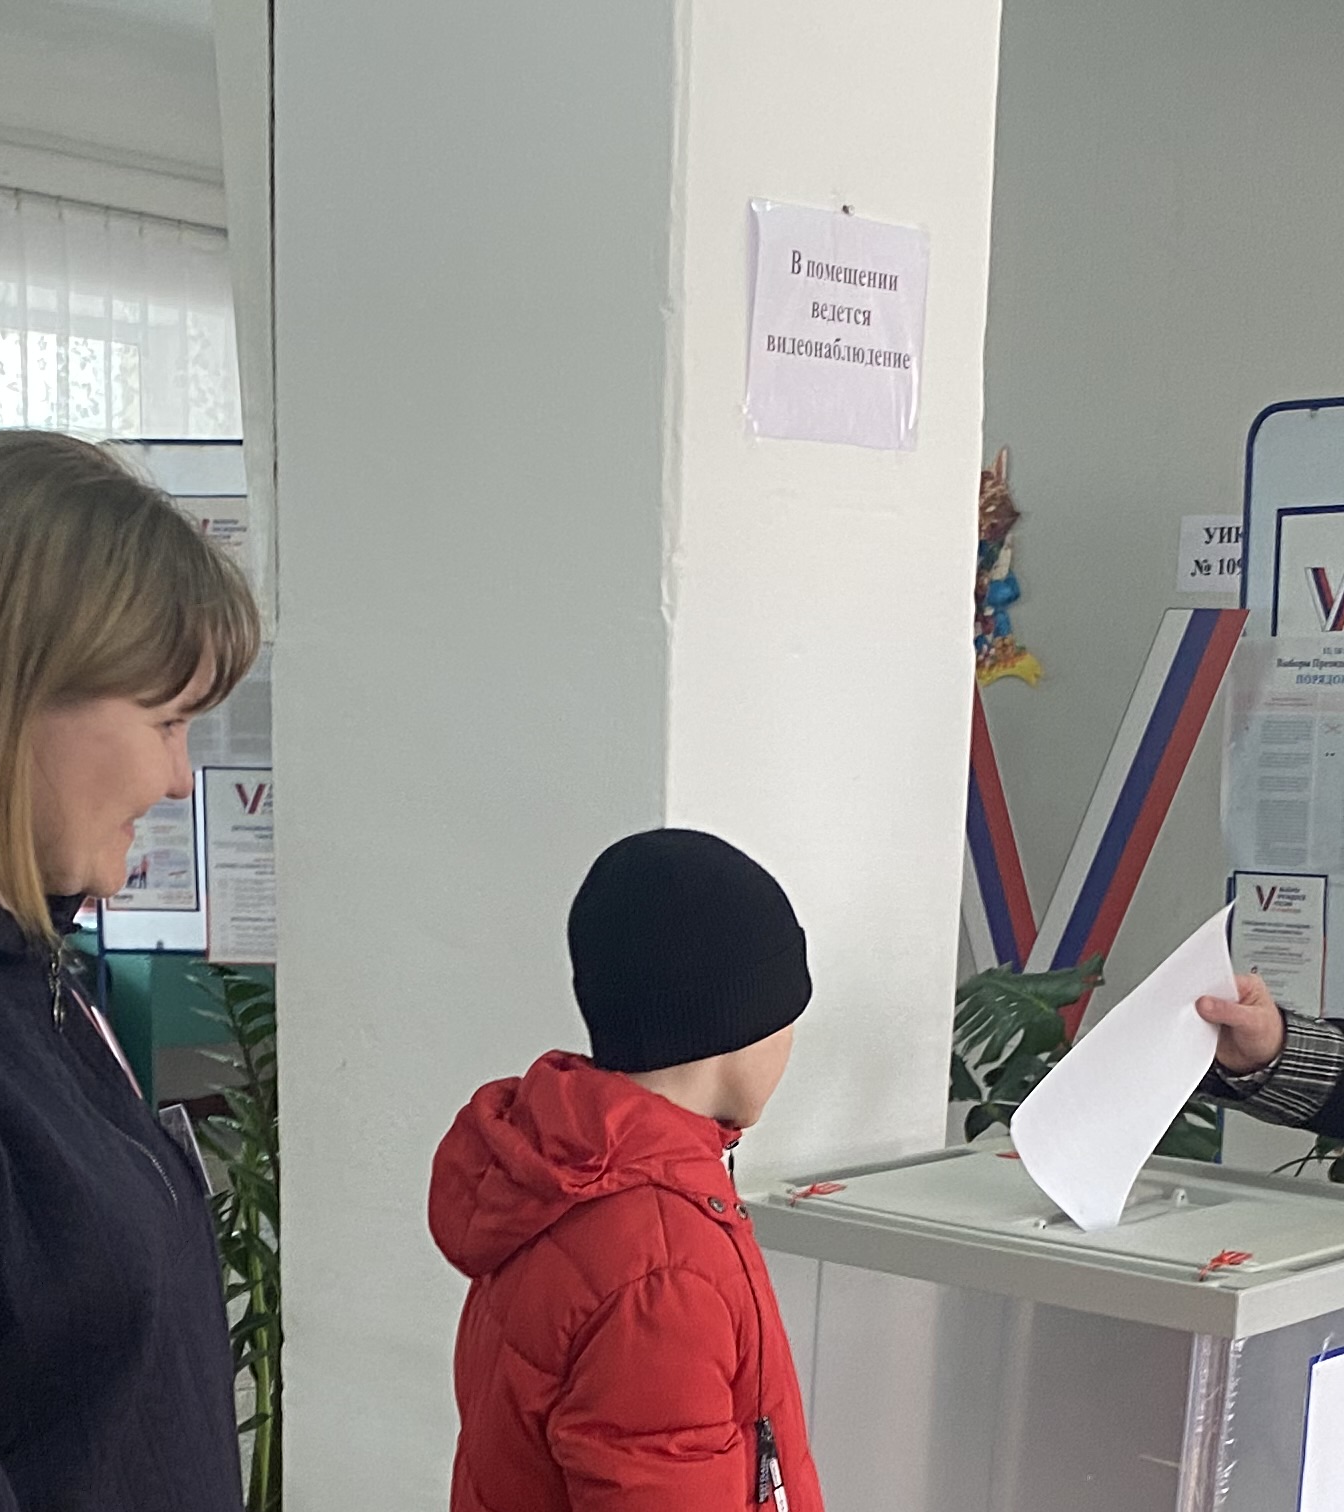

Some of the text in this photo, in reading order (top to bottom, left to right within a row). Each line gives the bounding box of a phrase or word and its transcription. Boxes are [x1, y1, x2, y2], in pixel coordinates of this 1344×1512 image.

[791, 250, 900, 292] В помещении
[811, 301, 872, 327] ведется
[766, 334, 912, 370] видеонаблюдение
